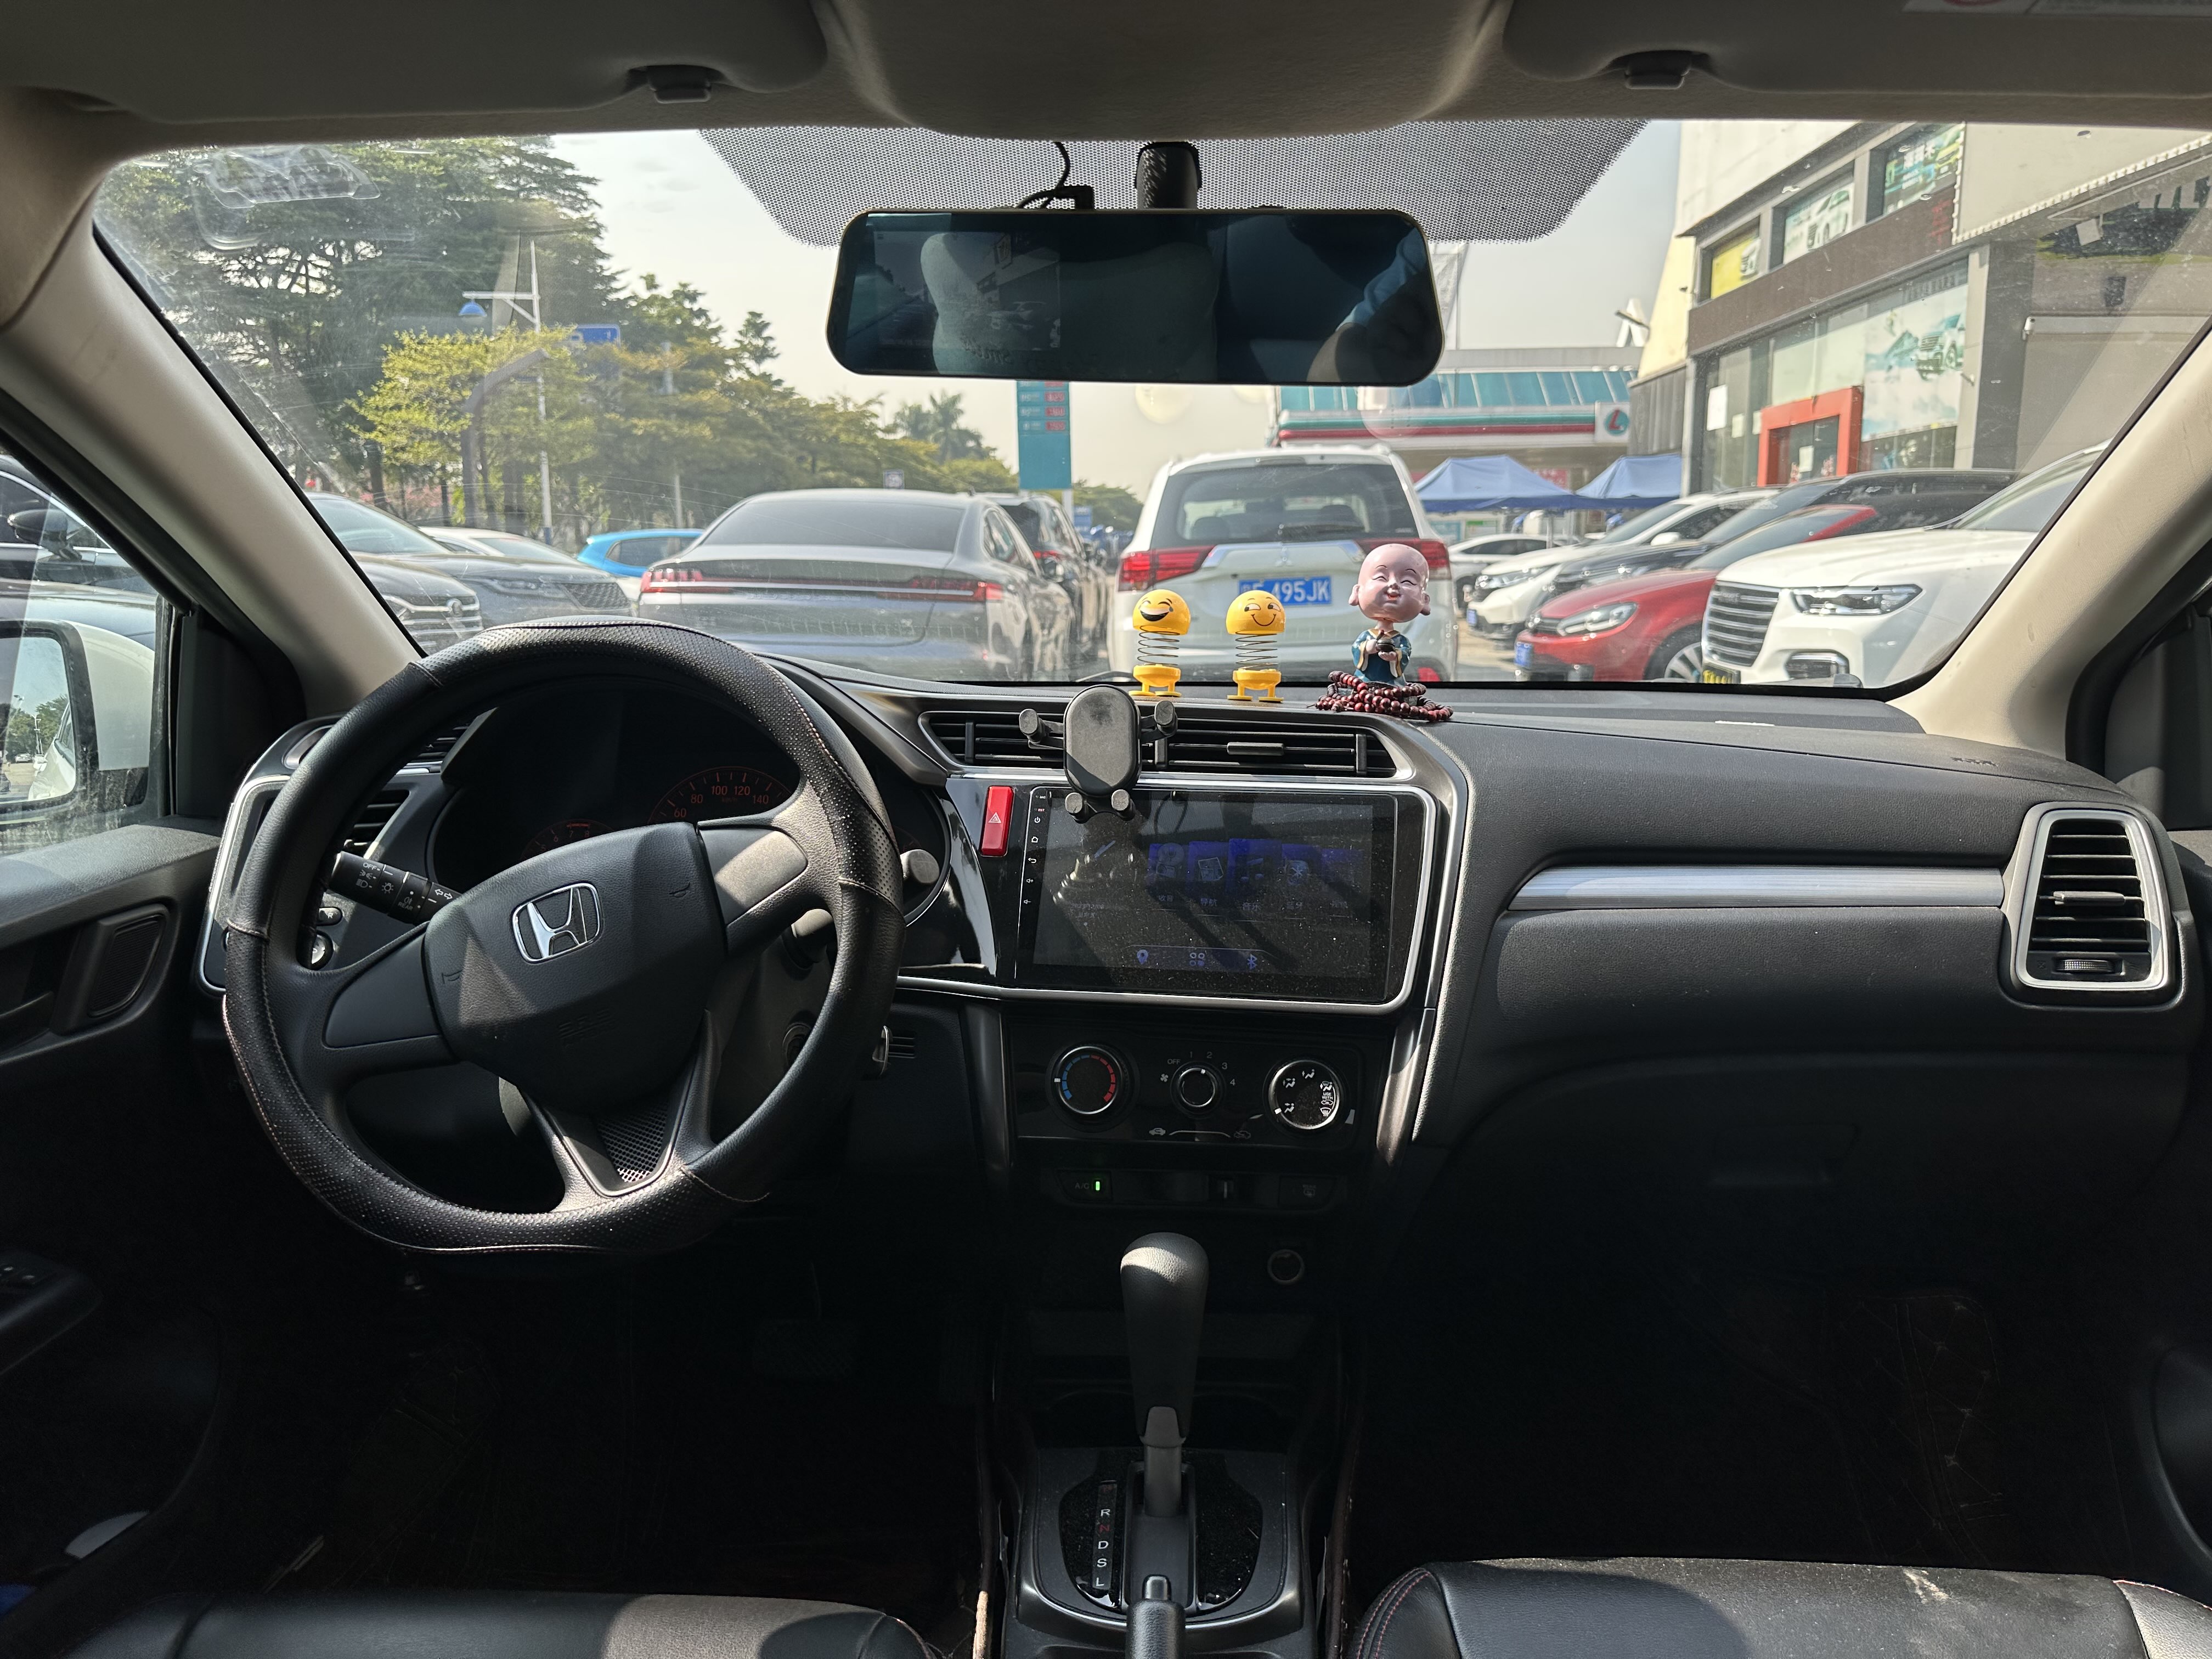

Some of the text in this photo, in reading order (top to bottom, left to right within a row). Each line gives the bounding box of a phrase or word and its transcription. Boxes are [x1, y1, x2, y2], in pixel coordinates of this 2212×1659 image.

[711, 786, 751, 795] 100 120
[690, 794, 703, 804] 80
[753, 795, 769, 805] 140
[674, 808, 687, 818] 60
[569, 830, 574, 838] 7
[363, 862, 377, 871] OFF
[397, 901, 414, 911] REAR
[1074, 1182, 1090, 1190] A/C
[1101, 1508, 1111, 1517] R
[1099, 1524, 1110, 1533] N
[1098, 1541, 1109, 1549] D
[1097, 1558, 1108, 1567] S
[1095, 1577, 1104, 1587] L
